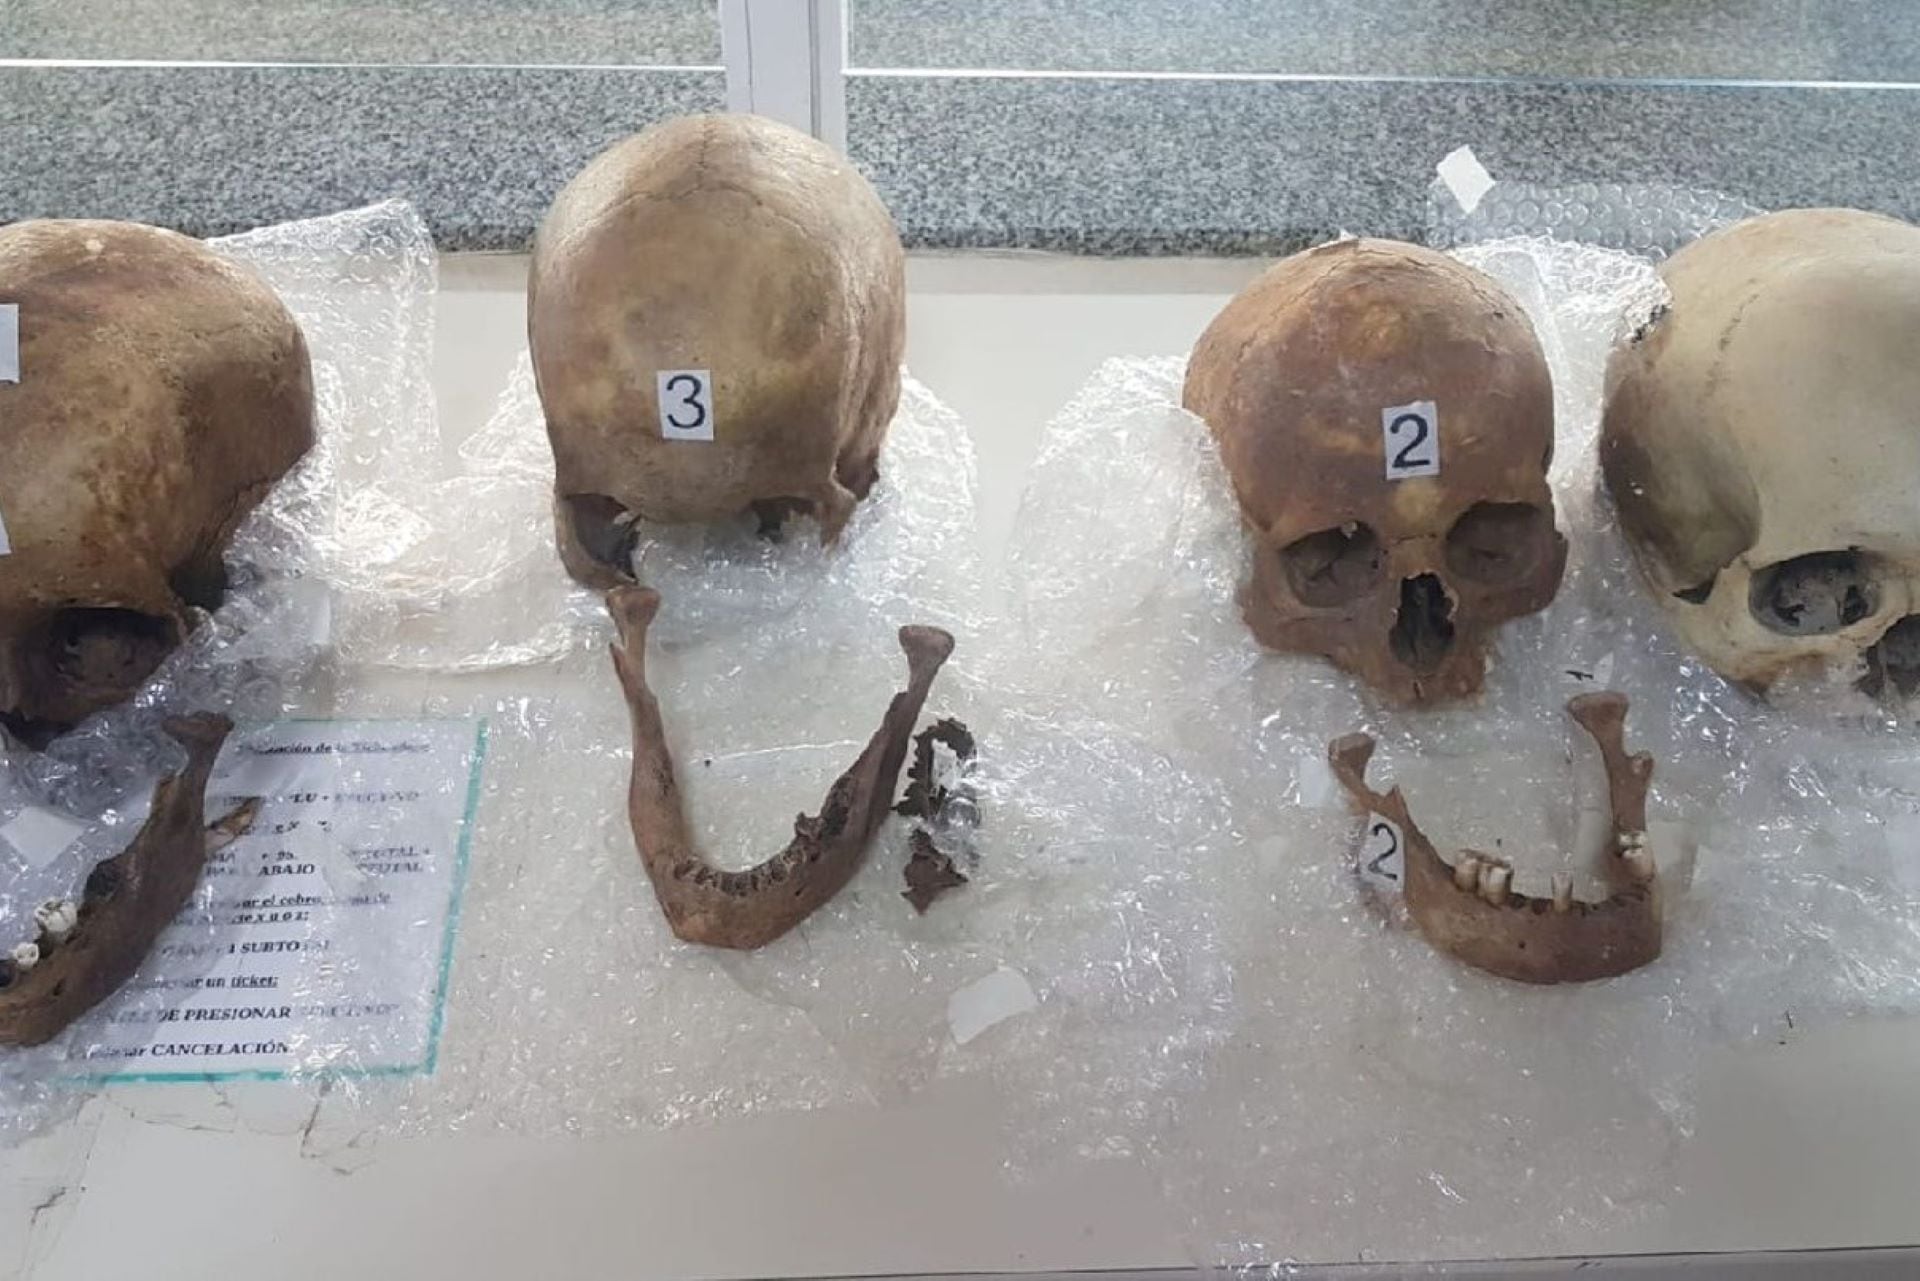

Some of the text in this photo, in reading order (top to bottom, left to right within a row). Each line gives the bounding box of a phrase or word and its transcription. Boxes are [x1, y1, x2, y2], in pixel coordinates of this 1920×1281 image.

[667, 375, 706, 429] 3
[1390, 413, 1431, 468] 2
[1367, 822, 1398, 881] 2
[257, 863, 316, 877] ABAJO
[205, 977, 226, 988] un
[183, 1006, 292, 1022] PRESIONAR
